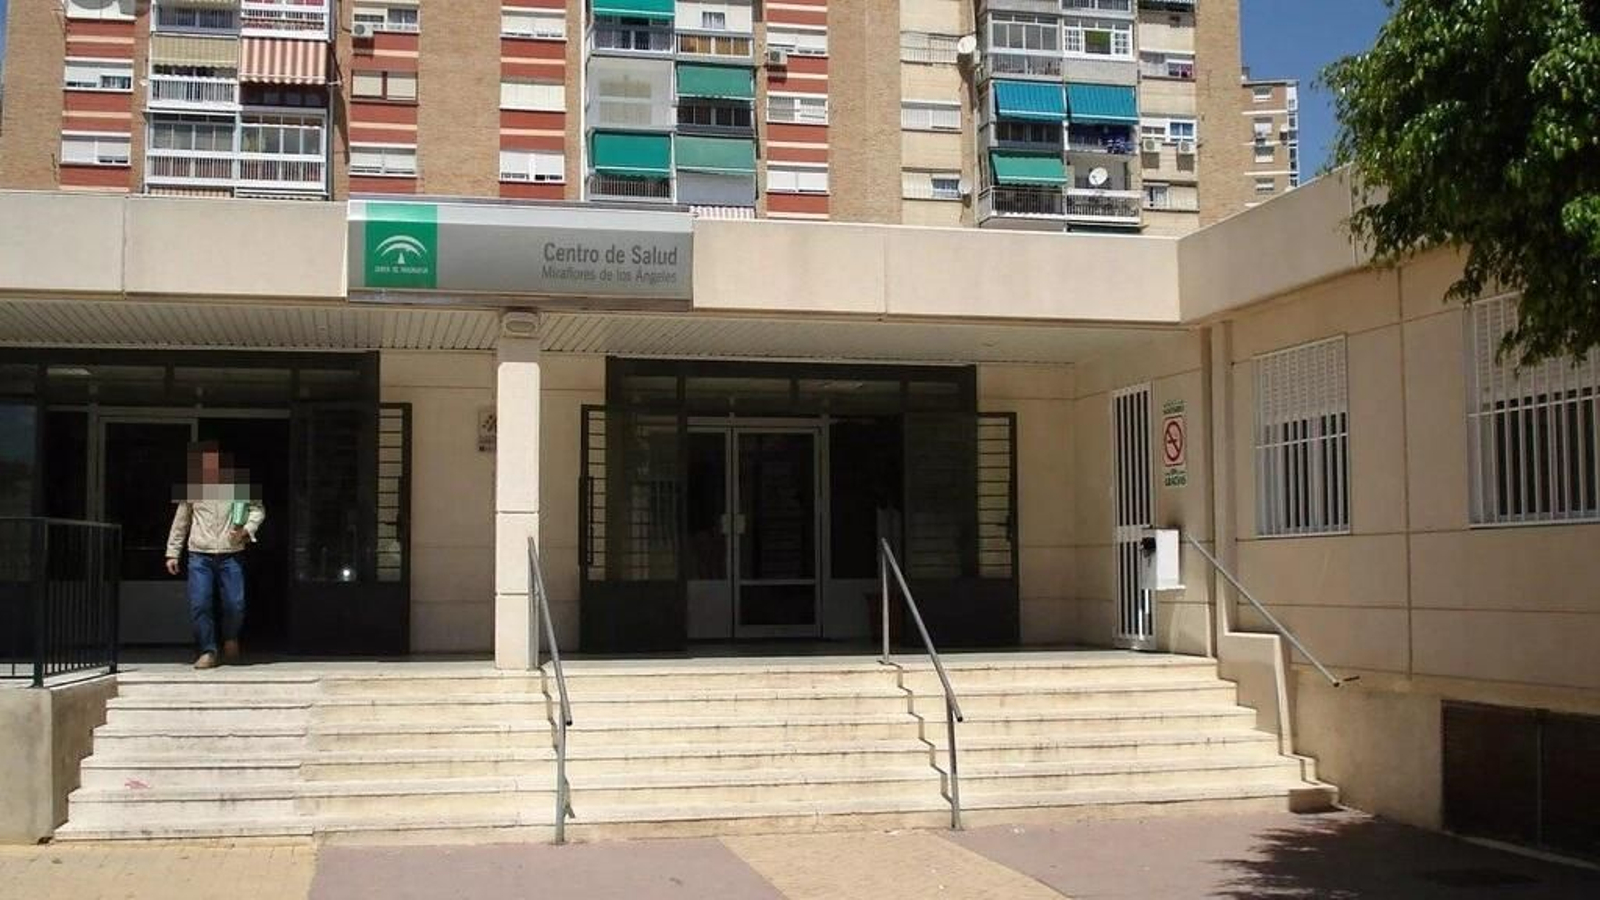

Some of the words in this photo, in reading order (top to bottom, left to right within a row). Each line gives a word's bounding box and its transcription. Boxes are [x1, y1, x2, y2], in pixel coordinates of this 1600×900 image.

[544, 242, 599, 263] Centro
[605, 244, 625, 263] de
[632, 245, 677, 265] Salud
[541, 265, 596, 281] Miraflores
[600, 267, 613, 281] de
[617, 268, 631, 282] los
